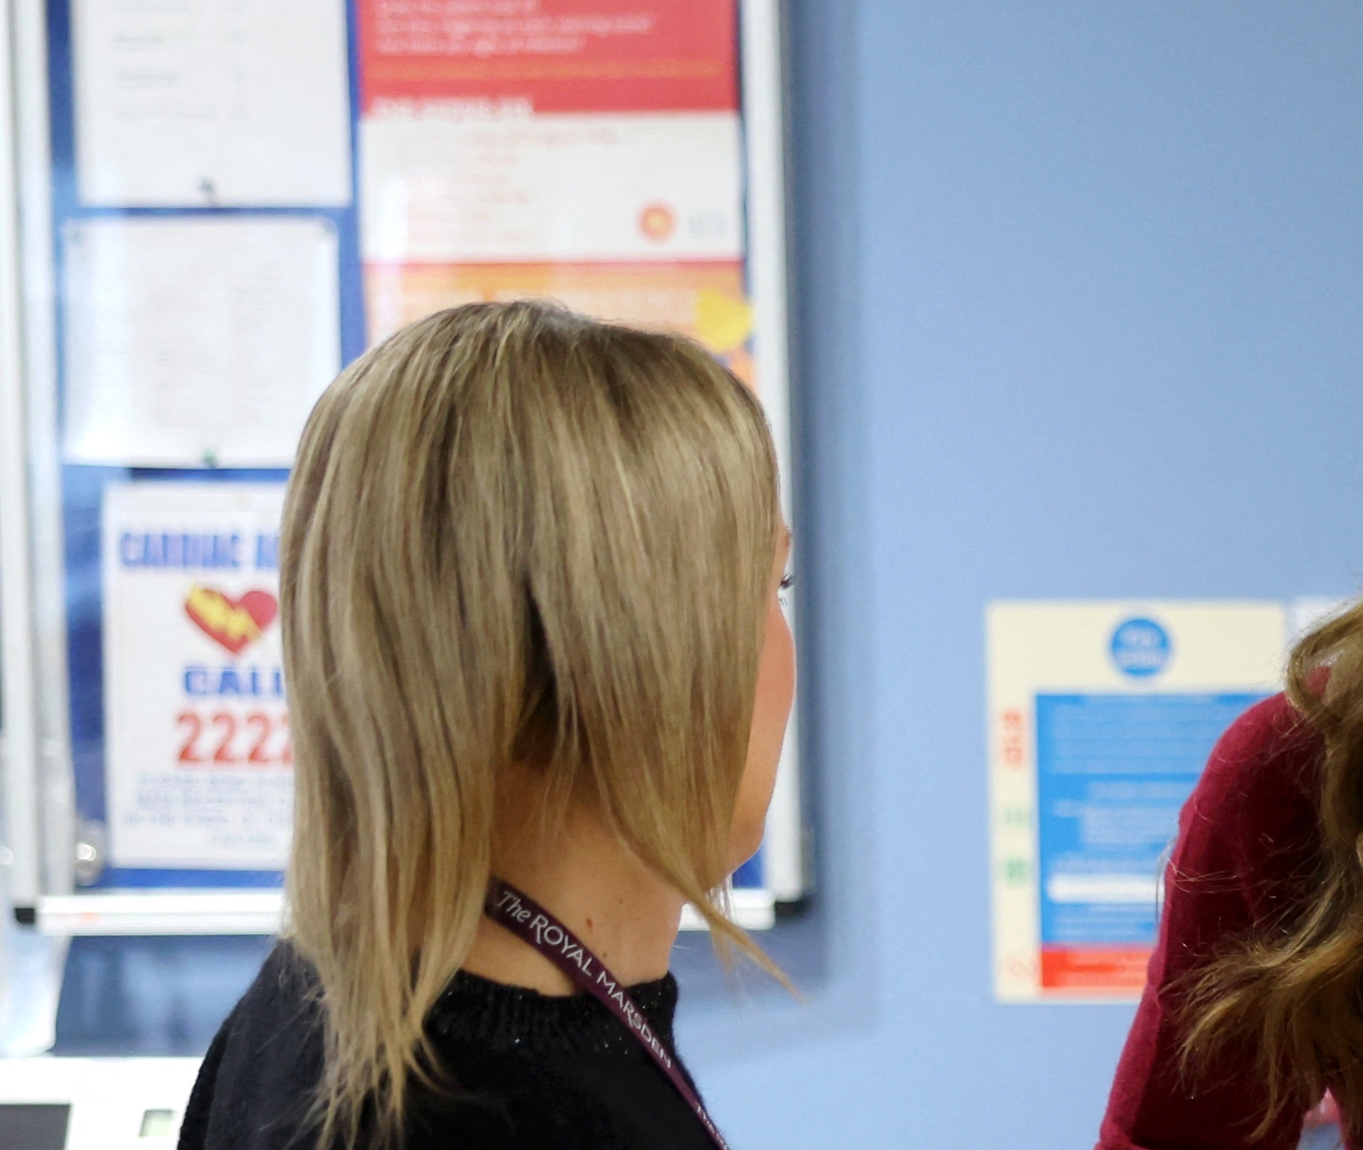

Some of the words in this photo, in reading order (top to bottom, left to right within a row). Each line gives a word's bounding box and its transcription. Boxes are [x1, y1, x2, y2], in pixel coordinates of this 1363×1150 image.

[497, 891, 531, 923] The
[531, 914, 593, 976] ROYAL
[597, 971, 672, 1069] MARSDEN
